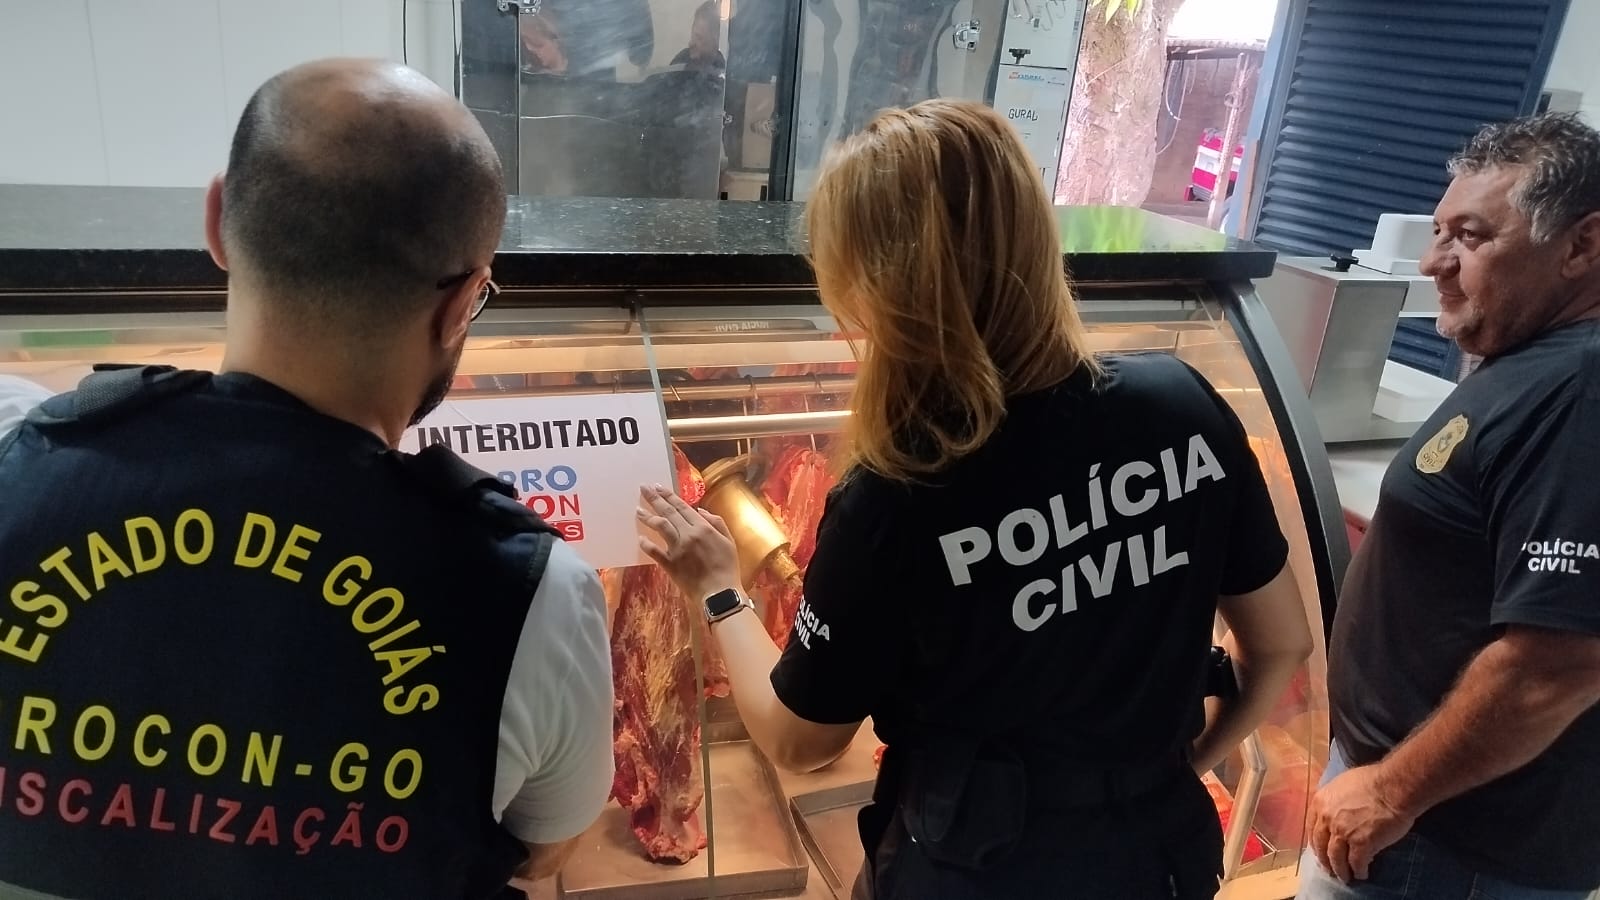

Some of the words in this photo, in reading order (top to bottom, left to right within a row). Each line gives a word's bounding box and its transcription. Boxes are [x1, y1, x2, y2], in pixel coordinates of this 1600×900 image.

[1008, 108, 1039, 121] GURAL
[417, 416, 640, 454] INTERDITADO
[938, 433, 1226, 587] POLÍCIA
[1012, 525, 1190, 632] CIVIL
[1521, 538, 1600, 559] OLÍCIA
[1527, 557, 1581, 574] CIVIL
[0, 508, 215, 663] ESTADO
[233, 512, 322, 583] DE
[322, 555, 446, 715] GOIÁS
[14, 695, 424, 800] ROCON-GO
